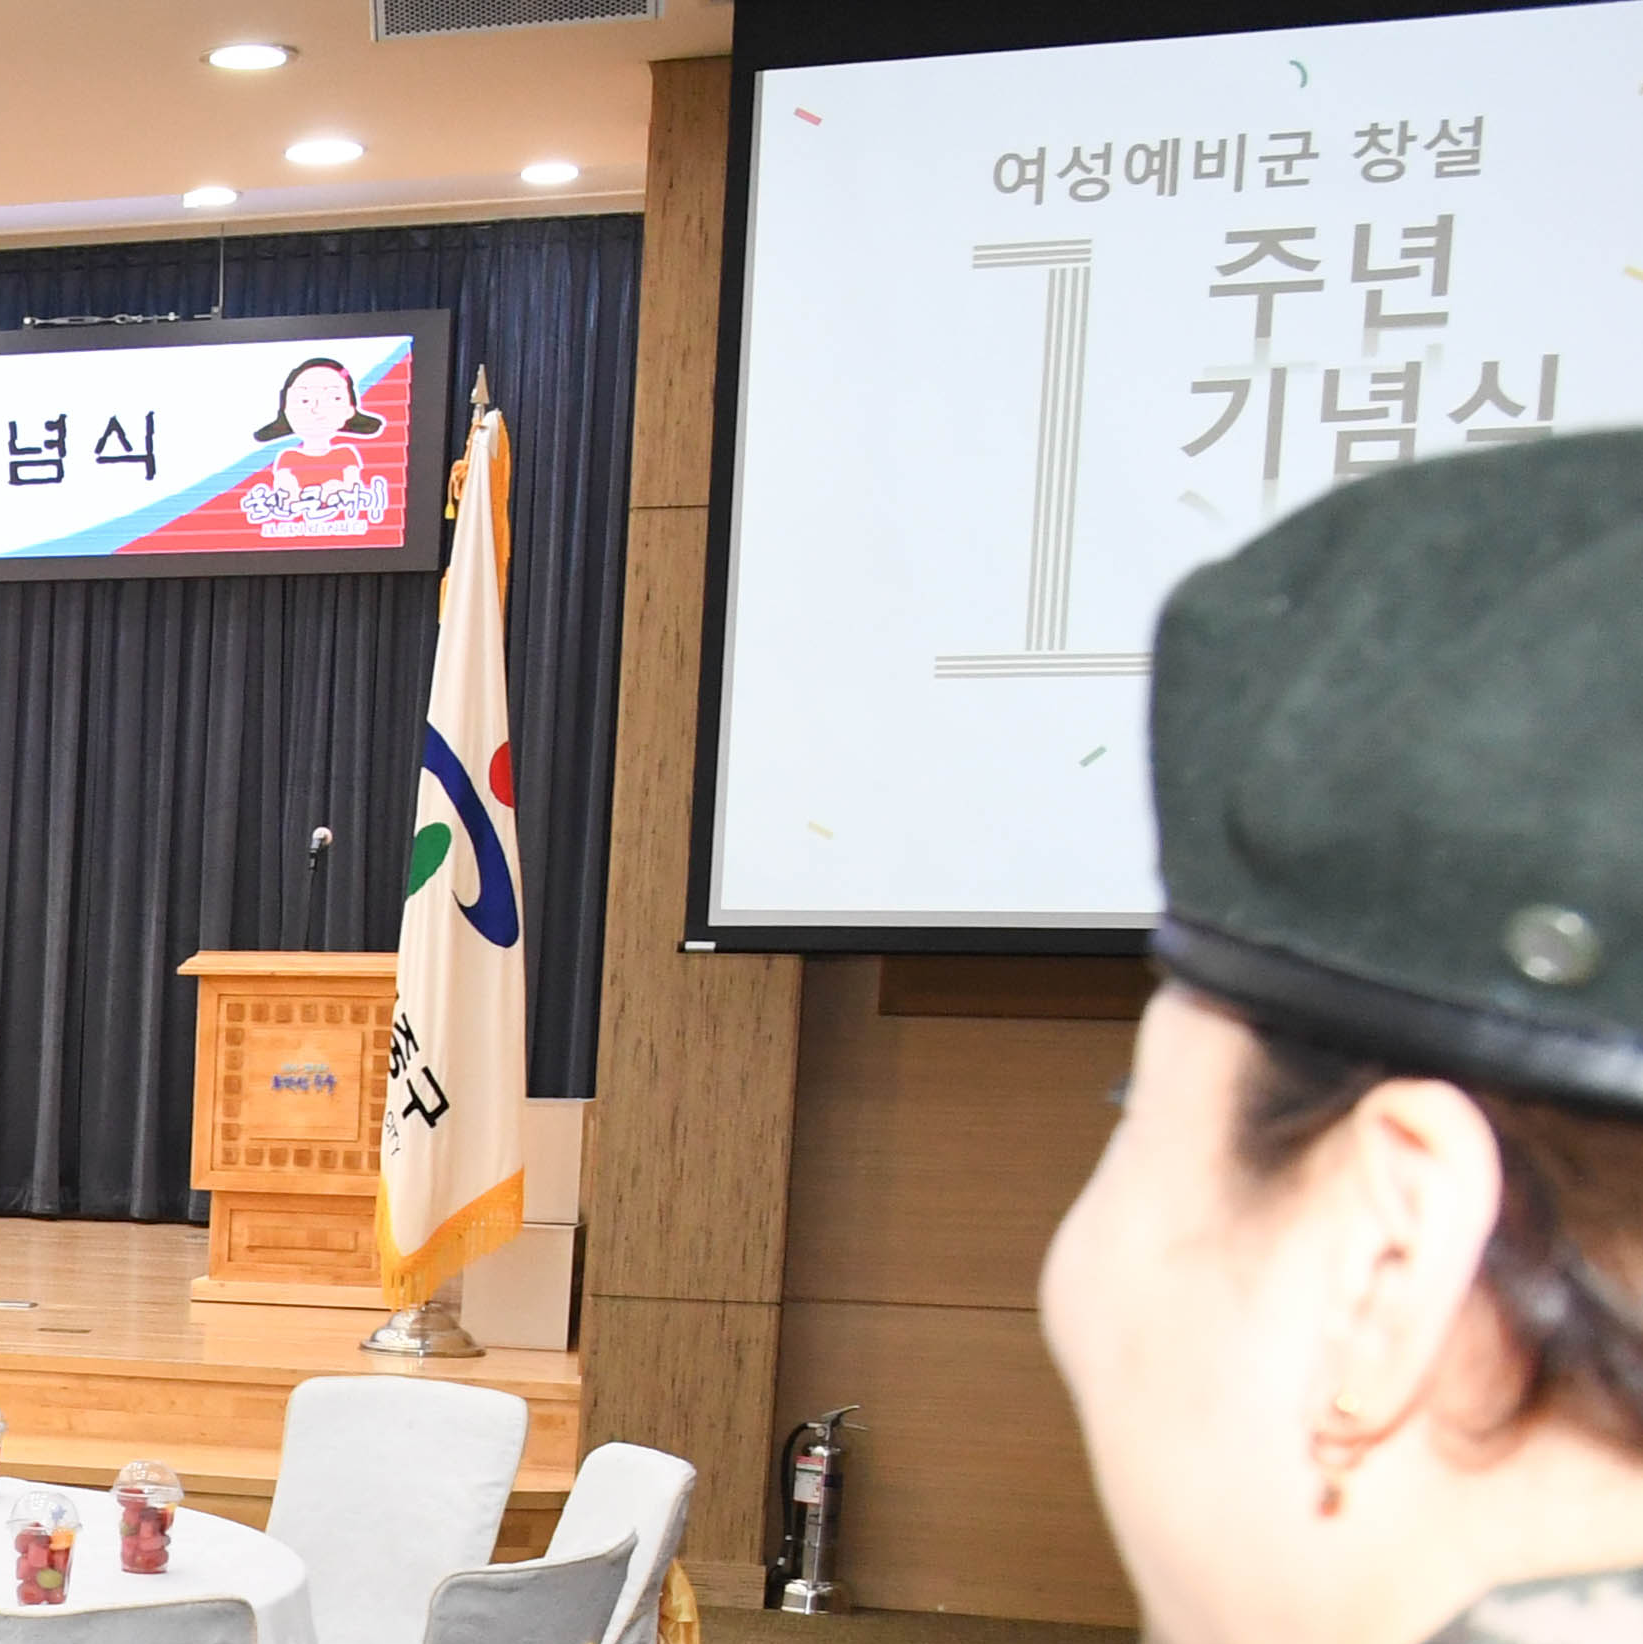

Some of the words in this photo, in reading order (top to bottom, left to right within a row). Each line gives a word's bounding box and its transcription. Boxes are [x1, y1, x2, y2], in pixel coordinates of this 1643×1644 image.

[993, 133, 1319, 206] 여성예비군
[1352, 116, 1485, 184] 창설
[1209, 214, 1456, 338] 주년
